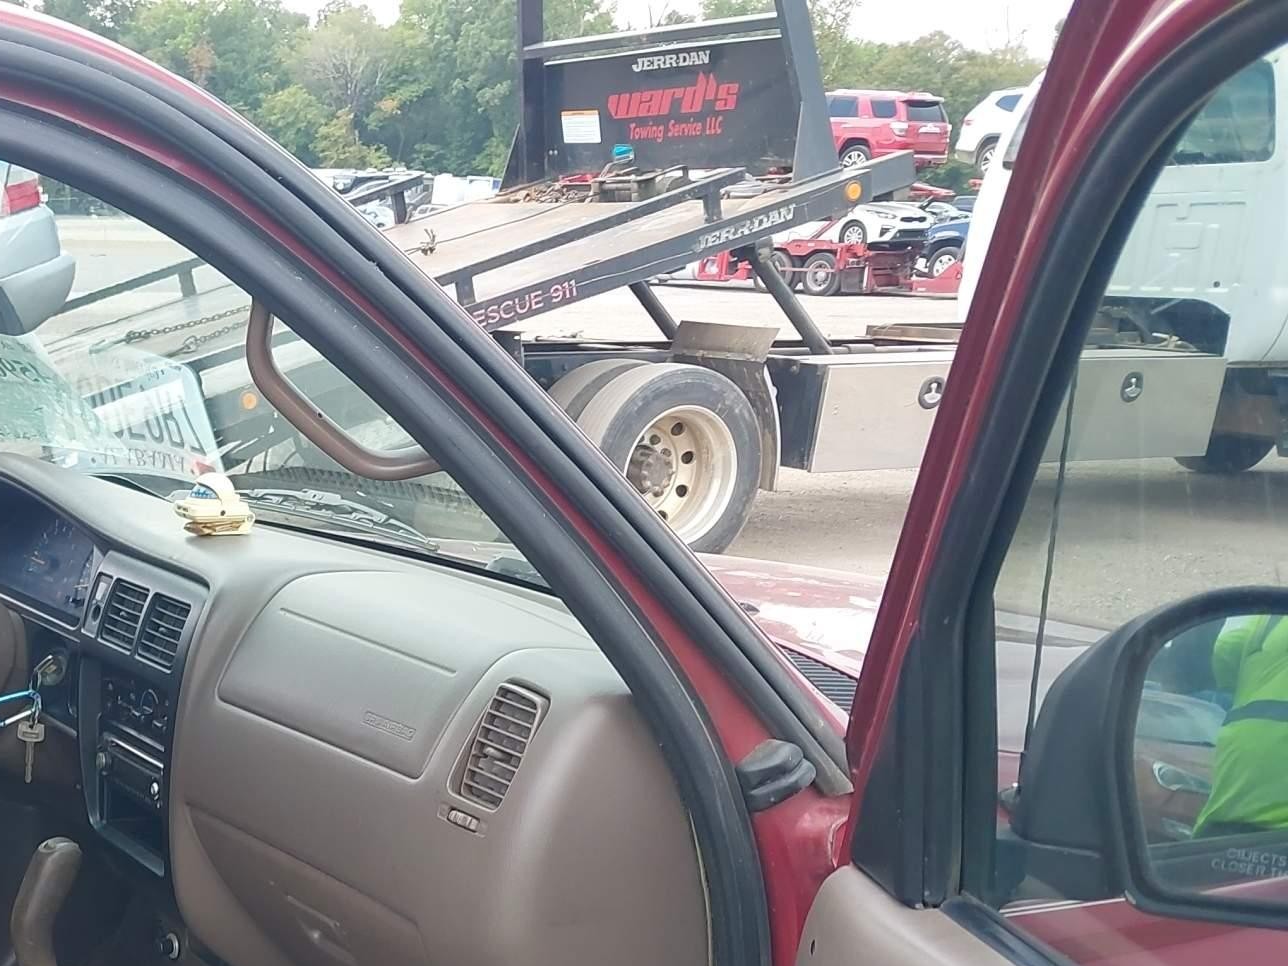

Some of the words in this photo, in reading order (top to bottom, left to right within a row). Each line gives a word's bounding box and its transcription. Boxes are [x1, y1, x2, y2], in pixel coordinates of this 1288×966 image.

[608, 71, 739, 119] ward's
[630, 121, 664, 143] Towing
[667, 117, 702, 137] Service
[706, 116, 723, 135] LLC
[473, 290, 544, 327] ESCUE
[550, 279, 578, 303] 911
